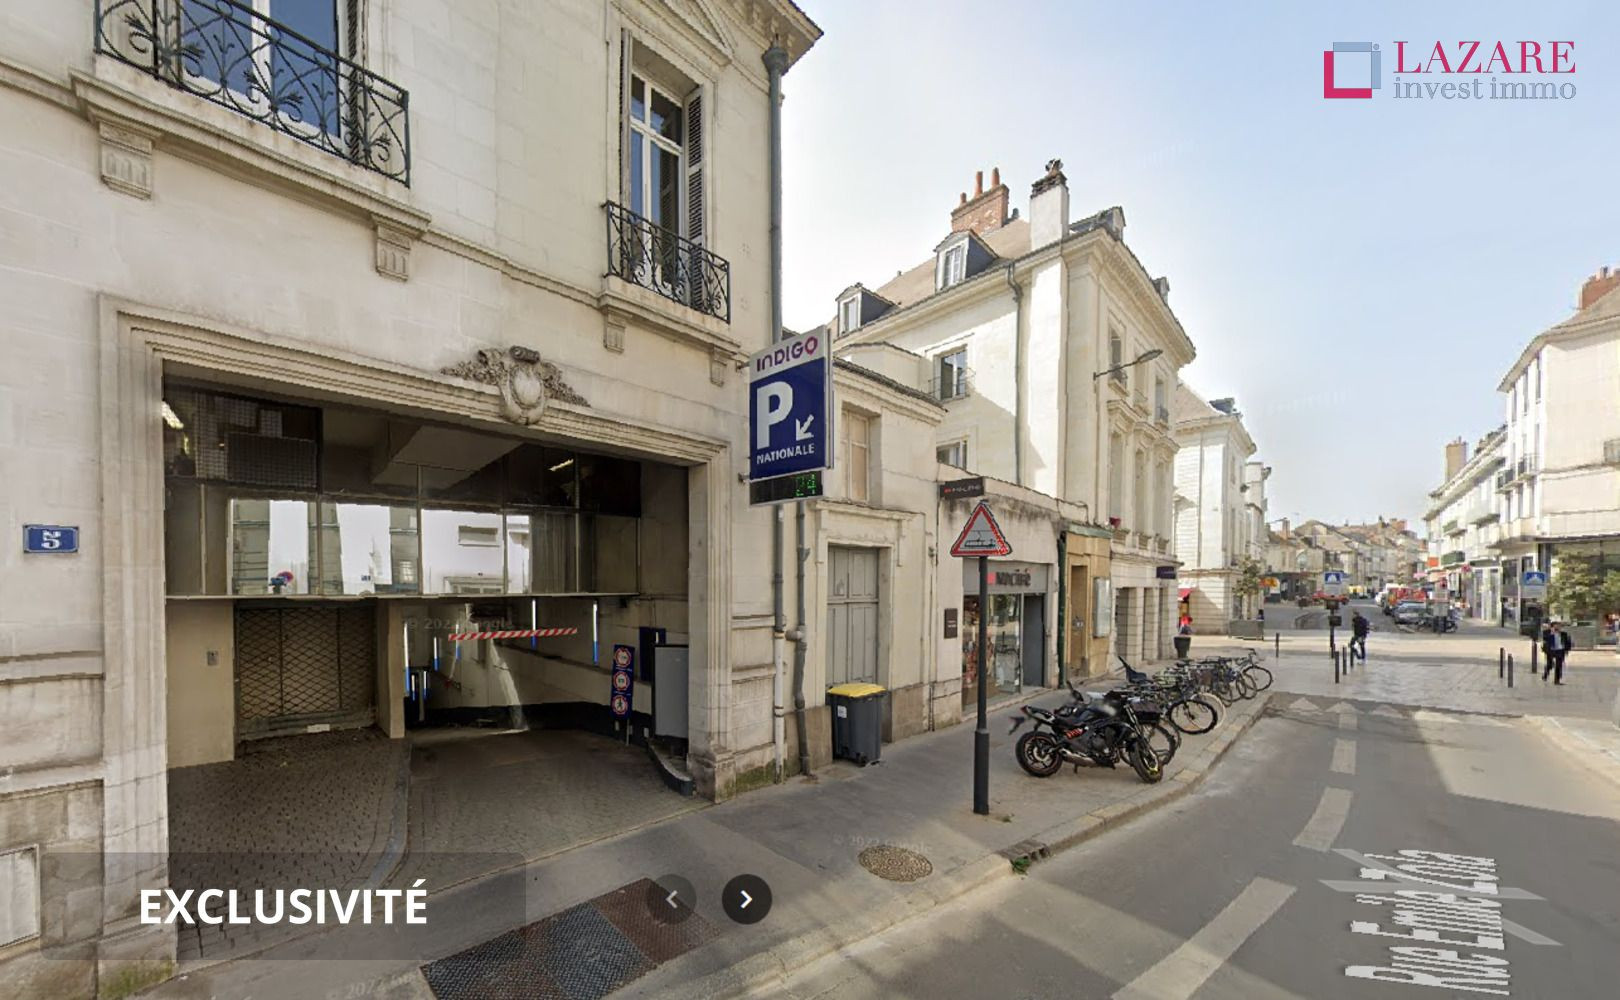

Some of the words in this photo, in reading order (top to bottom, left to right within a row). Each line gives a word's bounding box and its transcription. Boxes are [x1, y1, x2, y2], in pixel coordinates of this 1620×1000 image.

[756, 381, 793, 450] P
[756, 443, 815, 465] NATIONALE
[41, 530, 61, 550] 5
